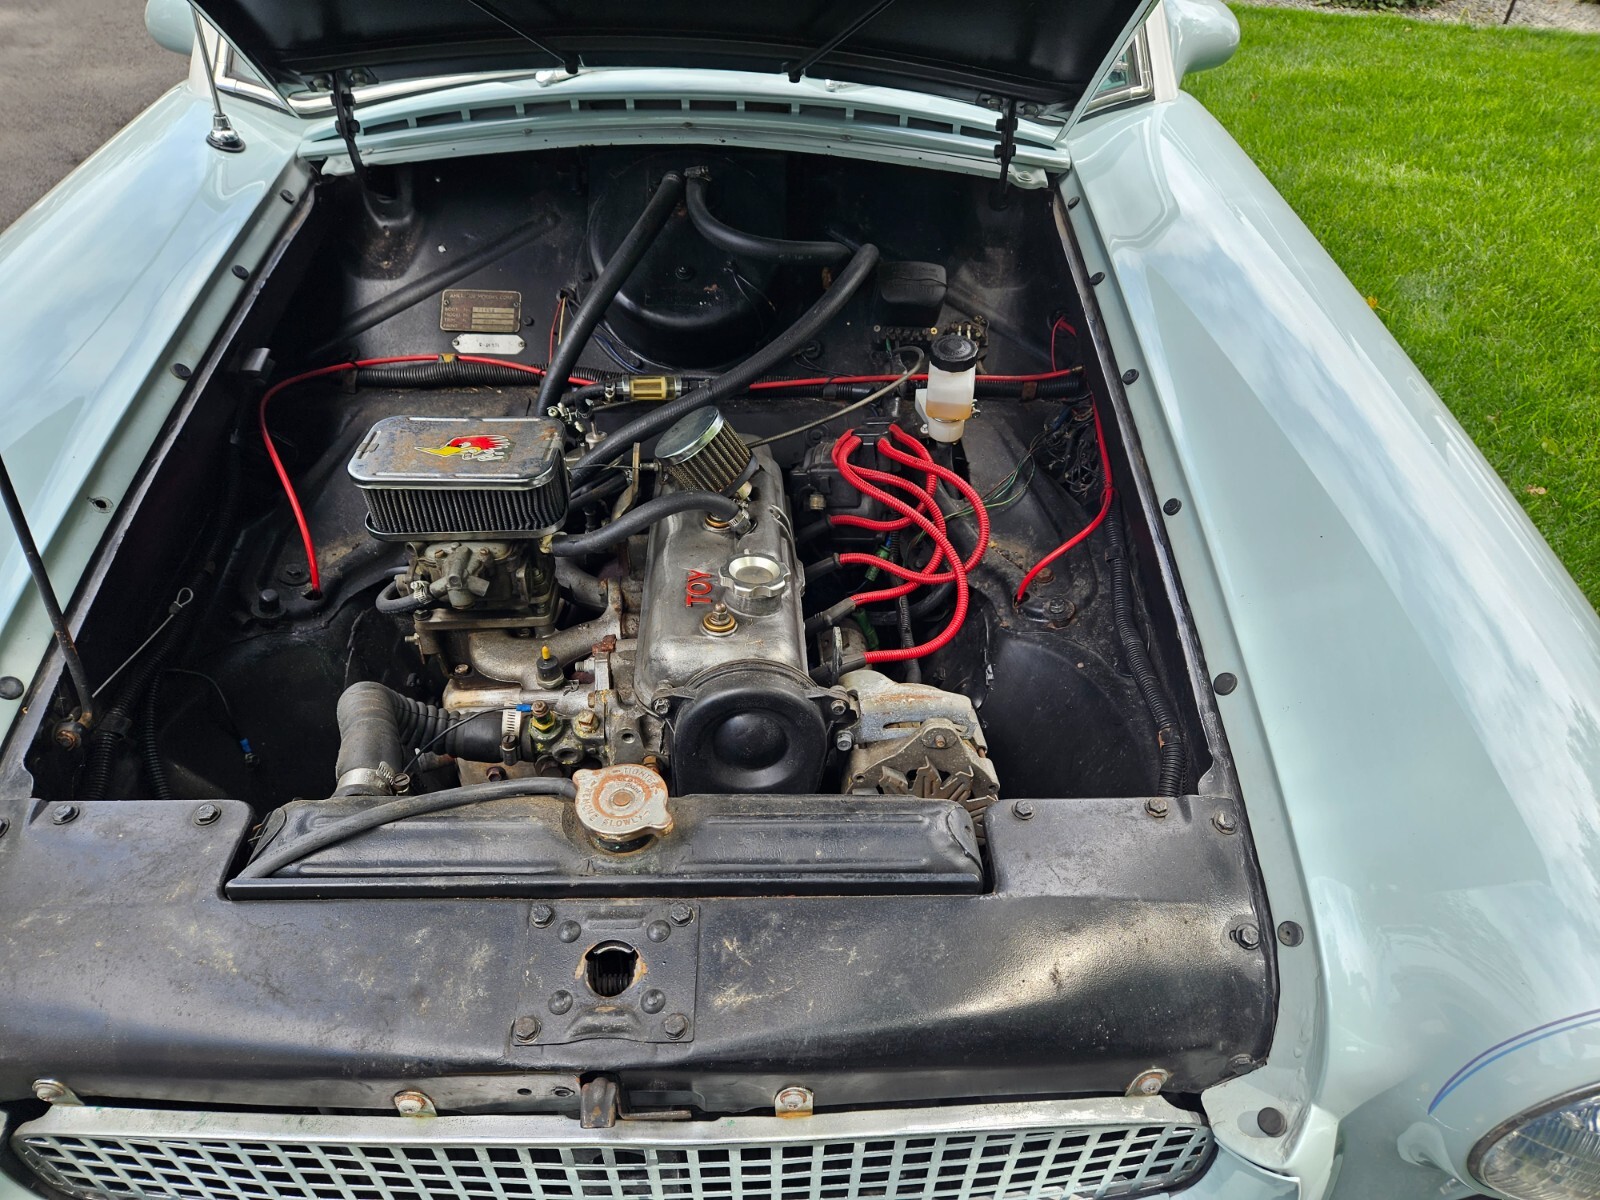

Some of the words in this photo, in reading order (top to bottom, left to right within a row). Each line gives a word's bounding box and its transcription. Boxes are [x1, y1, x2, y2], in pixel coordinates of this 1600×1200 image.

[685, 569, 712, 607] TOY
[582, 787, 599, 822] REMOVE
[602, 814, 644, 827] SLOWLY
